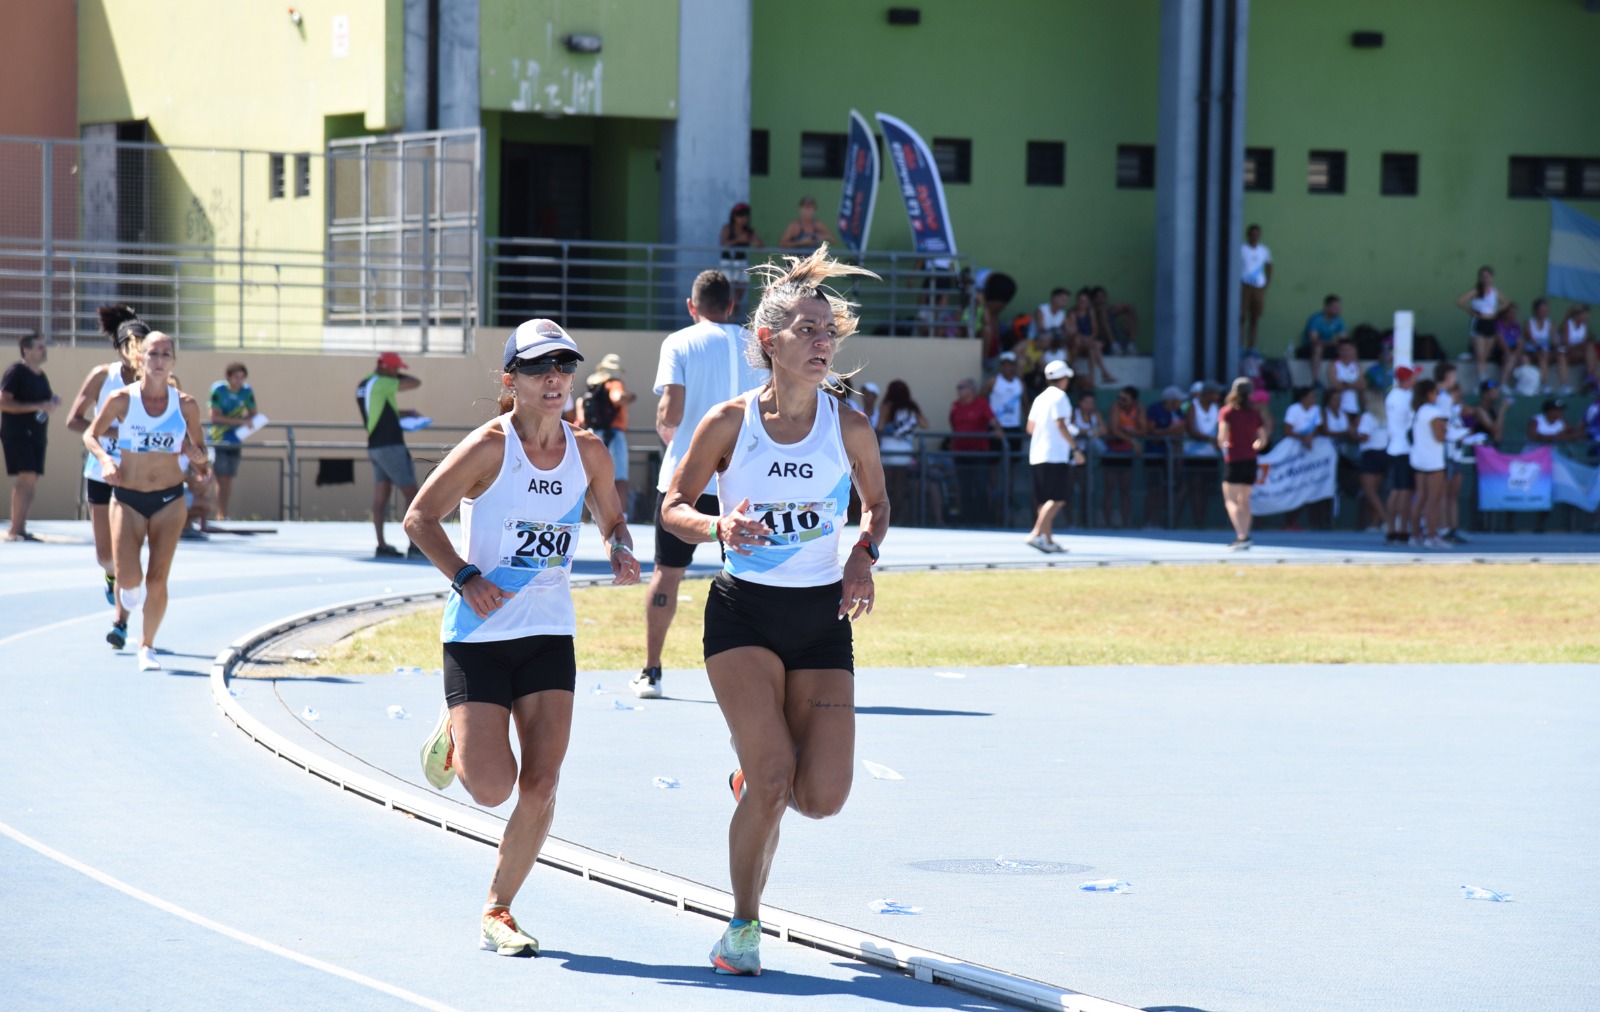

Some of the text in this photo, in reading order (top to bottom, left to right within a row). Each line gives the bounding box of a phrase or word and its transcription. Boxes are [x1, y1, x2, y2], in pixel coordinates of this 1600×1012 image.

[767, 462, 813, 479] ARG
[528, 478, 563, 496] ARG
[515, 530, 571, 557] 280
